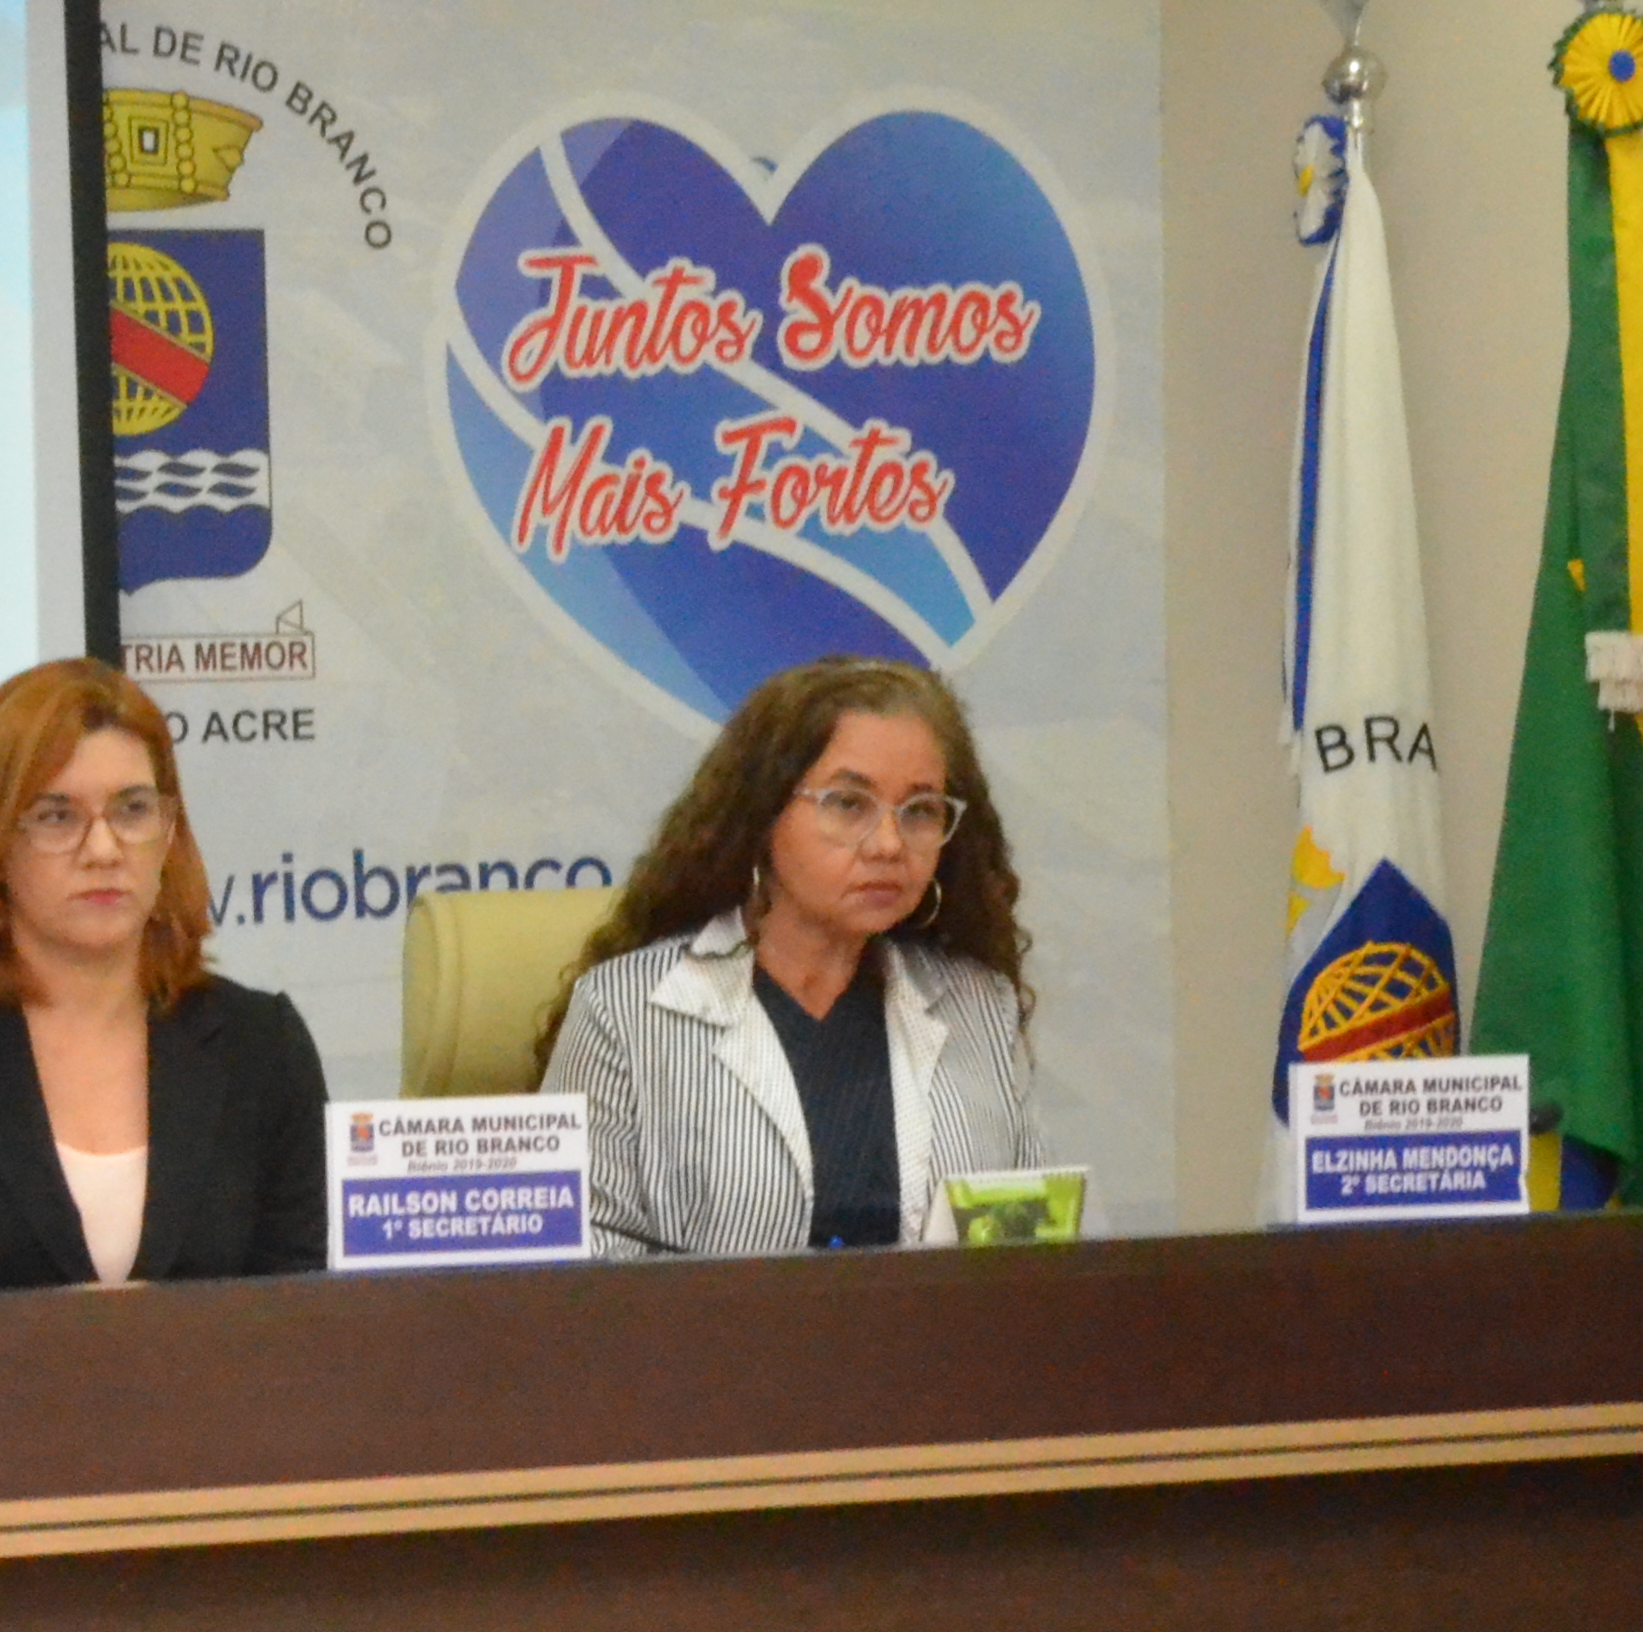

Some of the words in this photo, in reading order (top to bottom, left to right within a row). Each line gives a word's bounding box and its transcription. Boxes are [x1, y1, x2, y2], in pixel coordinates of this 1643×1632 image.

[152, 26, 205, 66] DE
[213, 41, 281, 94] RIO
[285, 80, 393, 250] BRANCO
[506, 249, 760, 387] Juntos
[781, 246, 1039, 362] Somos
[515, 419, 685, 558] Mais
[715, 414, 950, 545] Fortes
[194, 640, 308, 672] MEMOR
[201, 708, 315, 743] ACRE
[1339, 1076, 1415, 1097] CÂMARA
[1423, 1074, 1523, 1094] MUNICIPAL
[1359, 1099, 1383, 1117] DE
[1389, 1098, 1420, 1116] RIO
[1427, 1096, 1503, 1114] BRANCO
[379, 1114, 464, 1137] CÂMARA
[472, 1112, 581, 1134] MUNICIPAL
[402, 1139, 428, 1158] DE
[435, 1138, 469, 1156] RIO
[477, 1135, 560, 1154] BRANCO
[1311, 1149, 1397, 1174] ELZINHA
[1403, 1143, 1514, 1172] MENDONÇA
[348, 1190, 458, 1218] RAILSON
[465, 1186, 575, 1213] CORREIA
[408, 1212, 543, 1239] SECRETÁRIO
